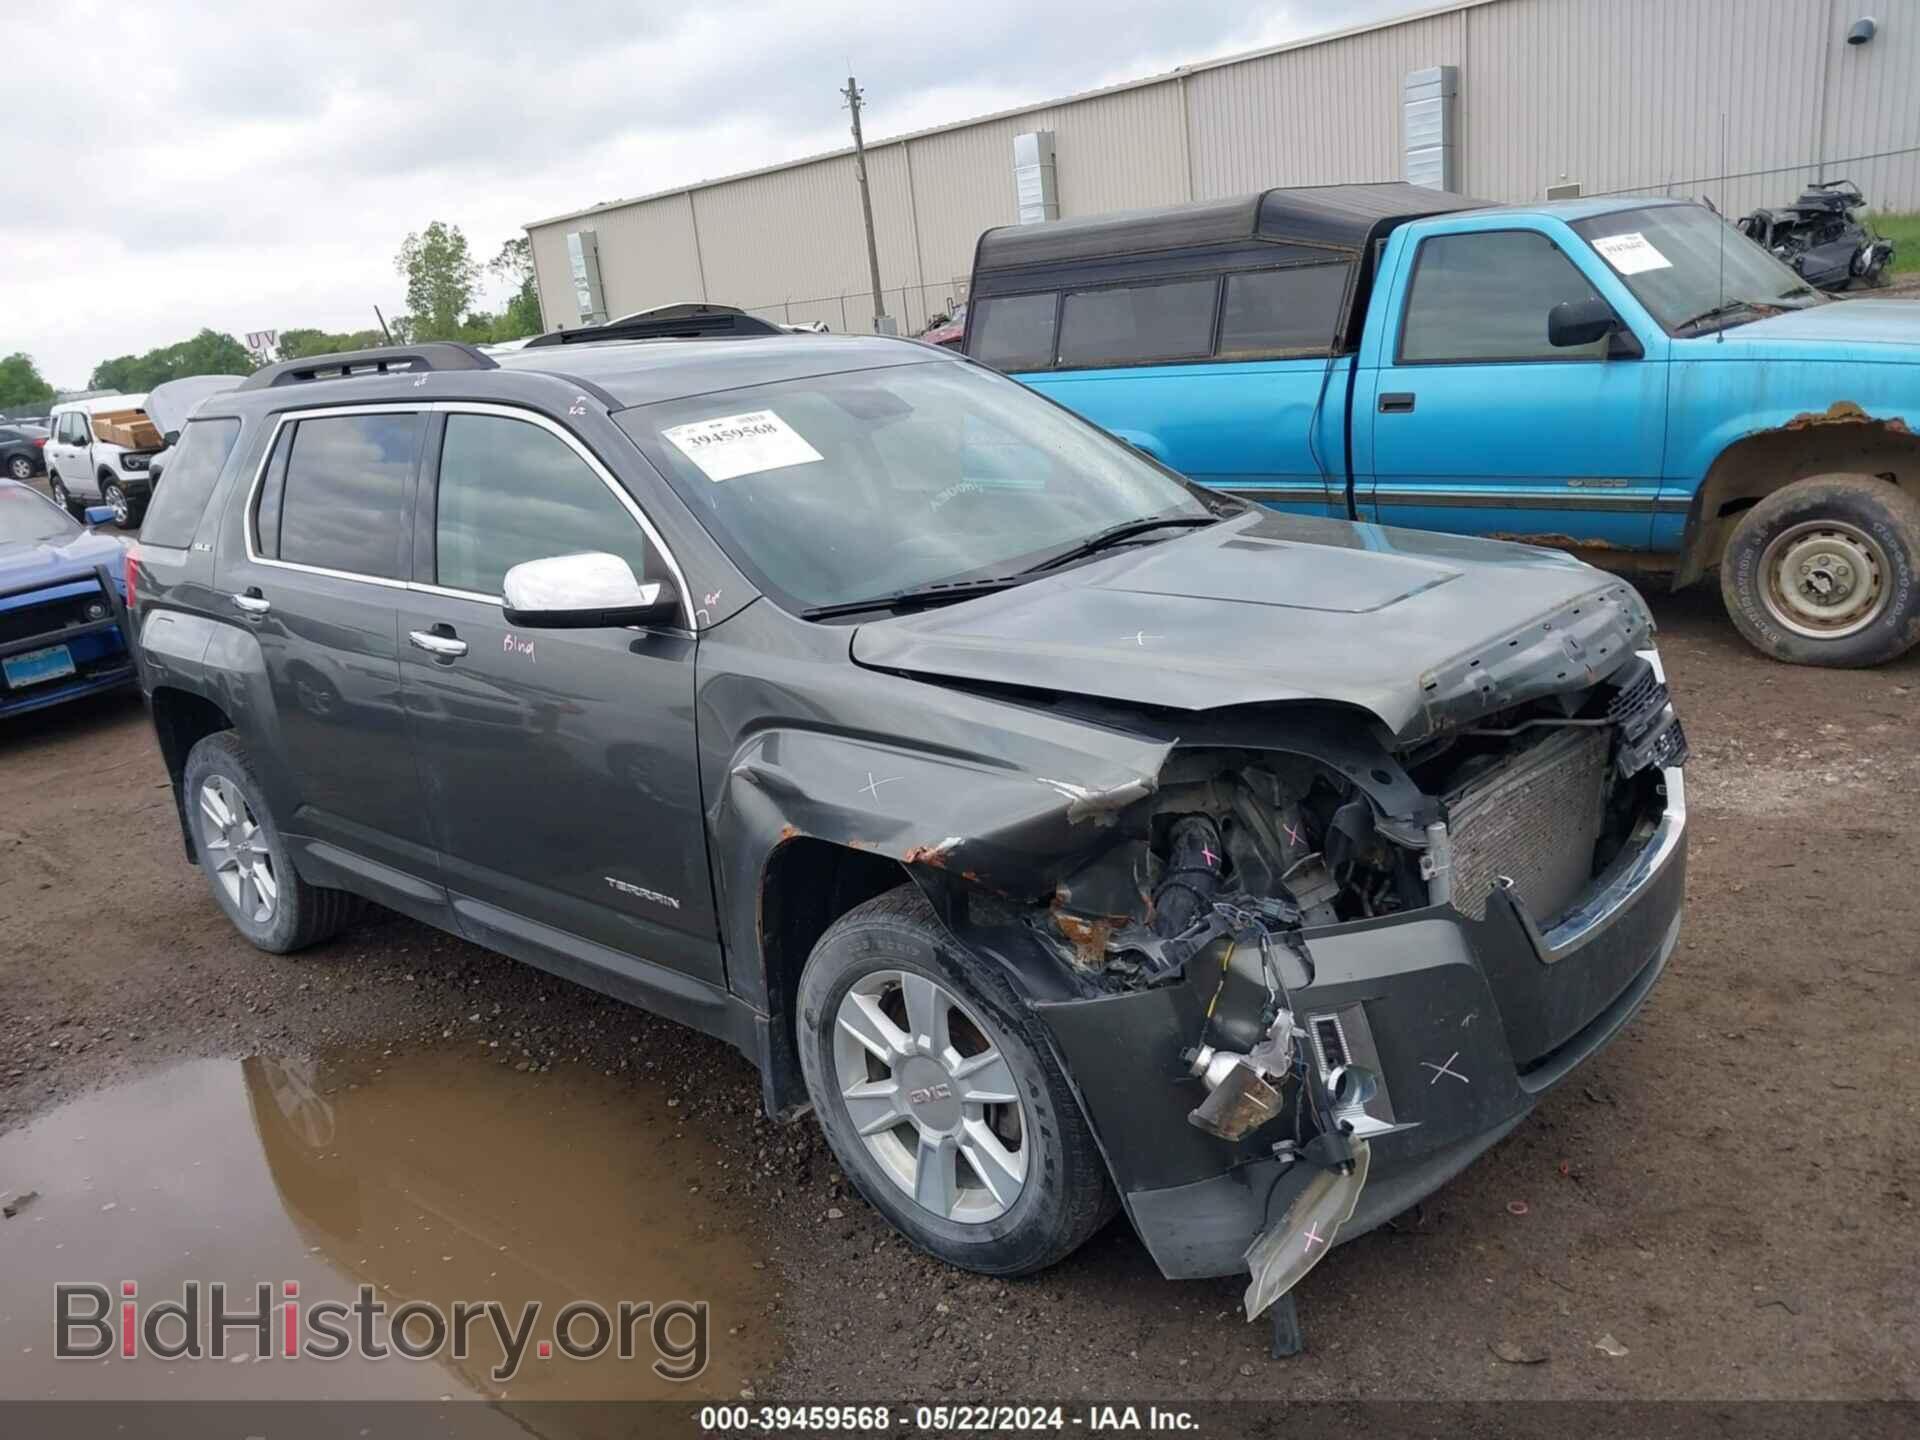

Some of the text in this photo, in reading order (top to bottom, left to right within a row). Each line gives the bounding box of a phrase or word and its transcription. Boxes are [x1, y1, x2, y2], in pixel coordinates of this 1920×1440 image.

[687, 423, 778, 449] 39459568
[604, 876, 680, 908] TERRAIN
[911, 1083, 951, 1102] GMC
